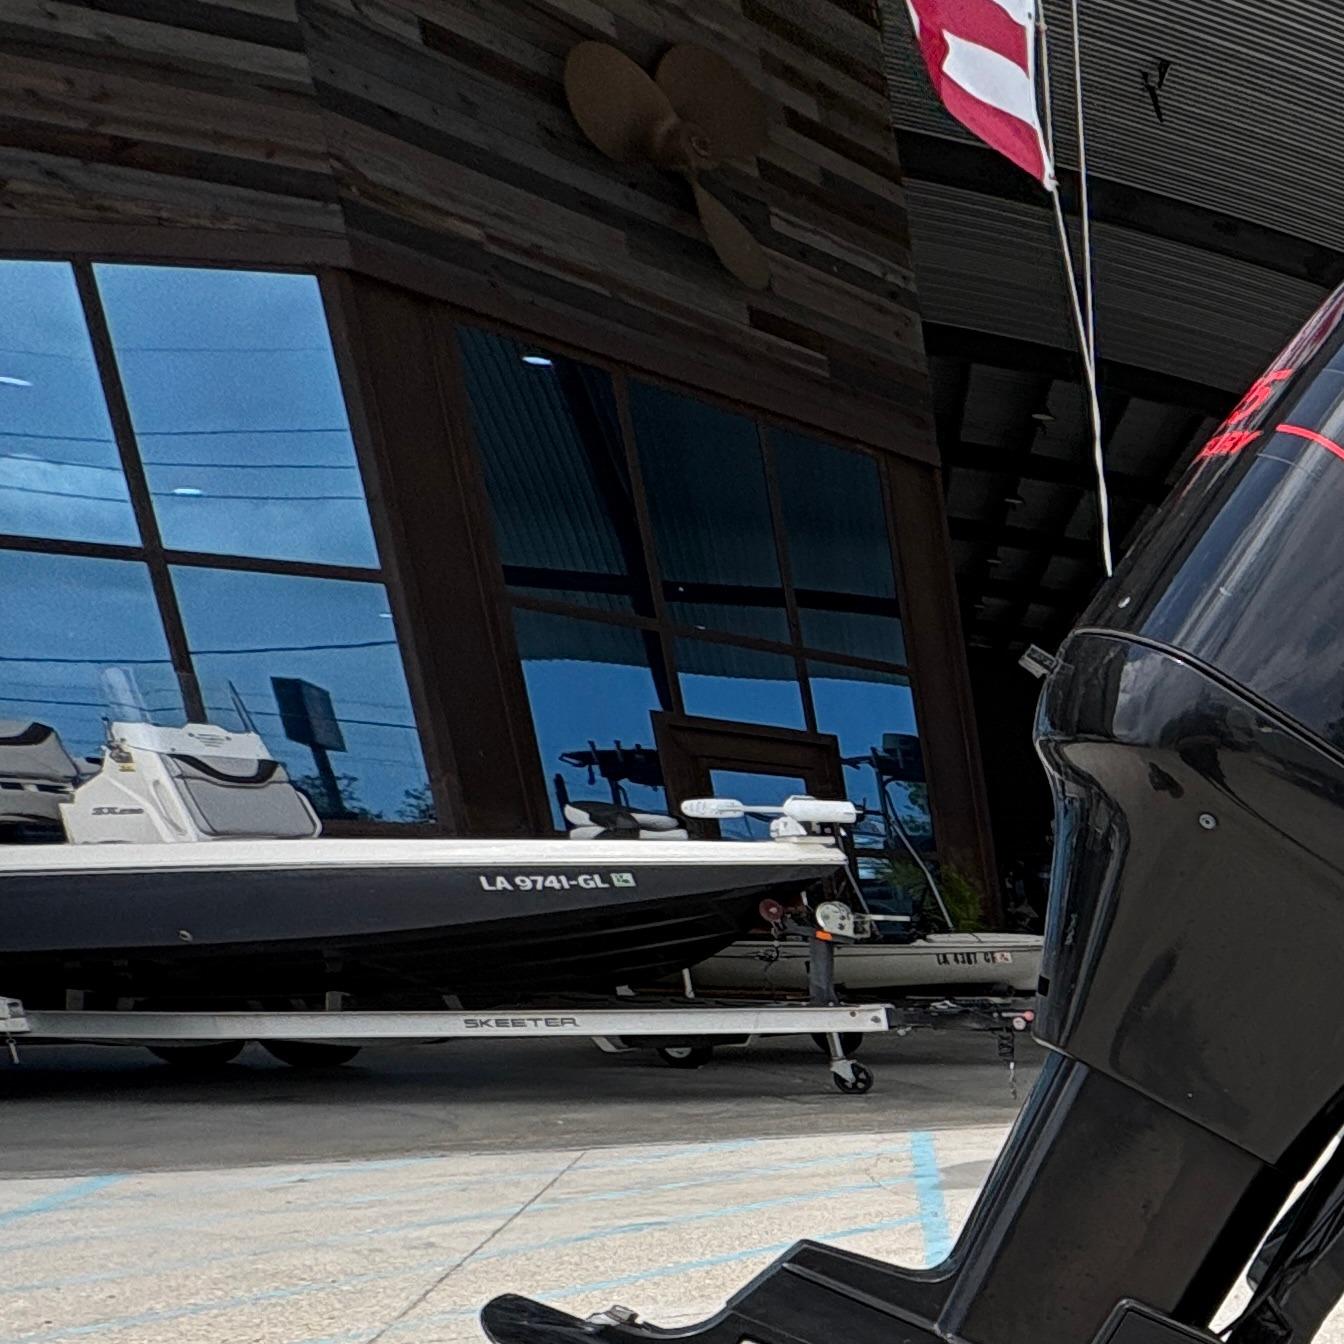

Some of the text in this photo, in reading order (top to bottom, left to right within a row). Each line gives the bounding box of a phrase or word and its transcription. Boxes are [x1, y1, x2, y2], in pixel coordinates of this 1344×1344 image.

[479, 874, 610, 891] LA 9741-GL
[463, 1017, 580, 1029] SKEETER
